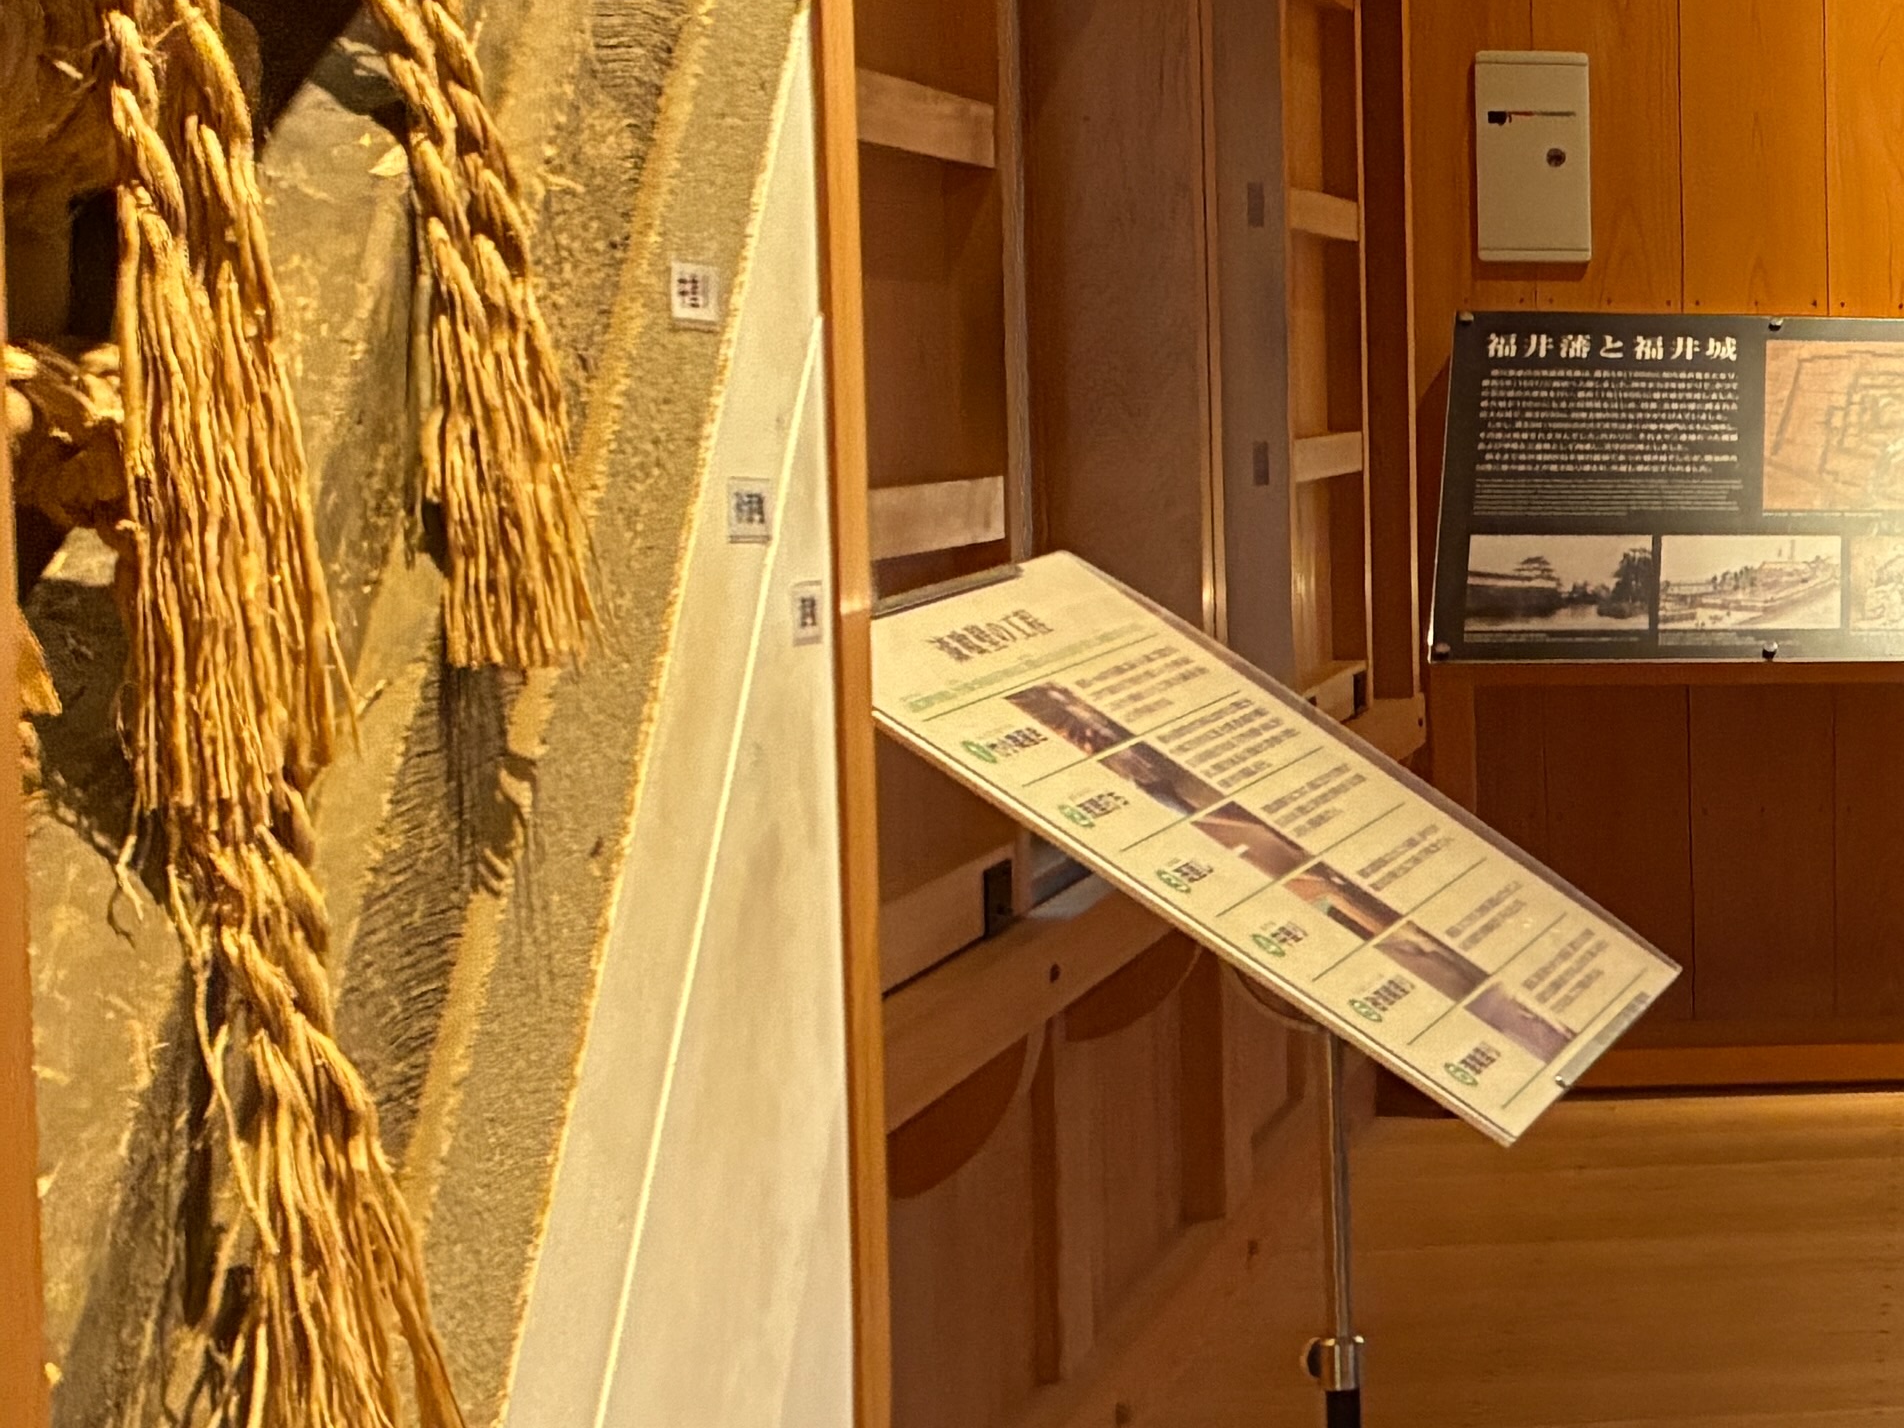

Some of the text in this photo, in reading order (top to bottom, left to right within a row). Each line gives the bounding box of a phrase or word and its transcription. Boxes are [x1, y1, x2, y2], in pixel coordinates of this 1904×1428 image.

[1487, 333, 1737, 361] 福井藩と福井城
